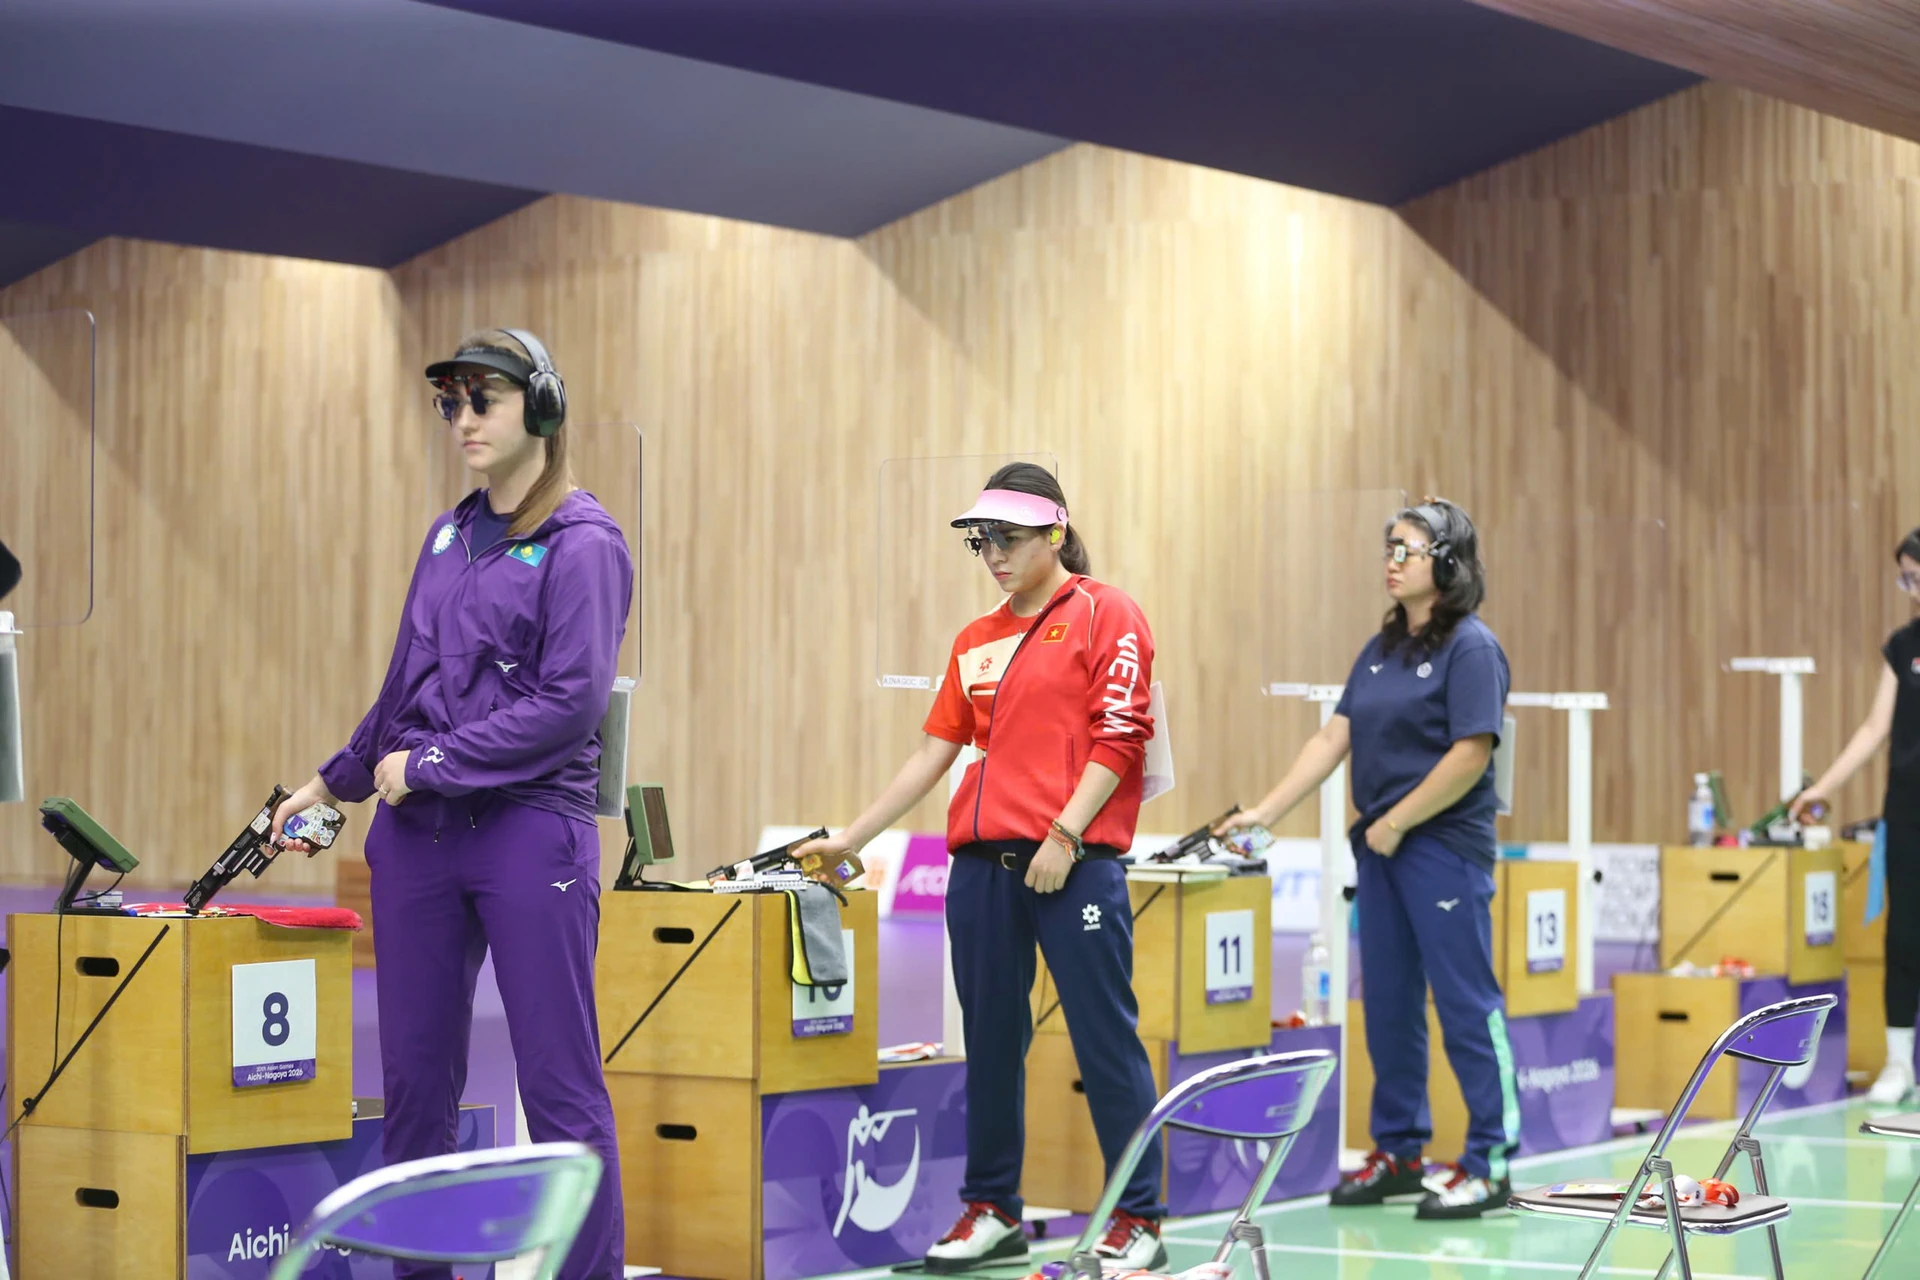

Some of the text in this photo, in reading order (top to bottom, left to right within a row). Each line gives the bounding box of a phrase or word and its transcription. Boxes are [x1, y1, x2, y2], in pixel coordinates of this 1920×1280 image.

[1102, 632, 1139, 734] VIETNM
[1535, 911, 1558, 947] 13
[1218, 934, 1241, 975] 11
[262, 991, 290, 1047] 8
[247, 1068, 304, 1081] Aichi-Nagoya 2026
